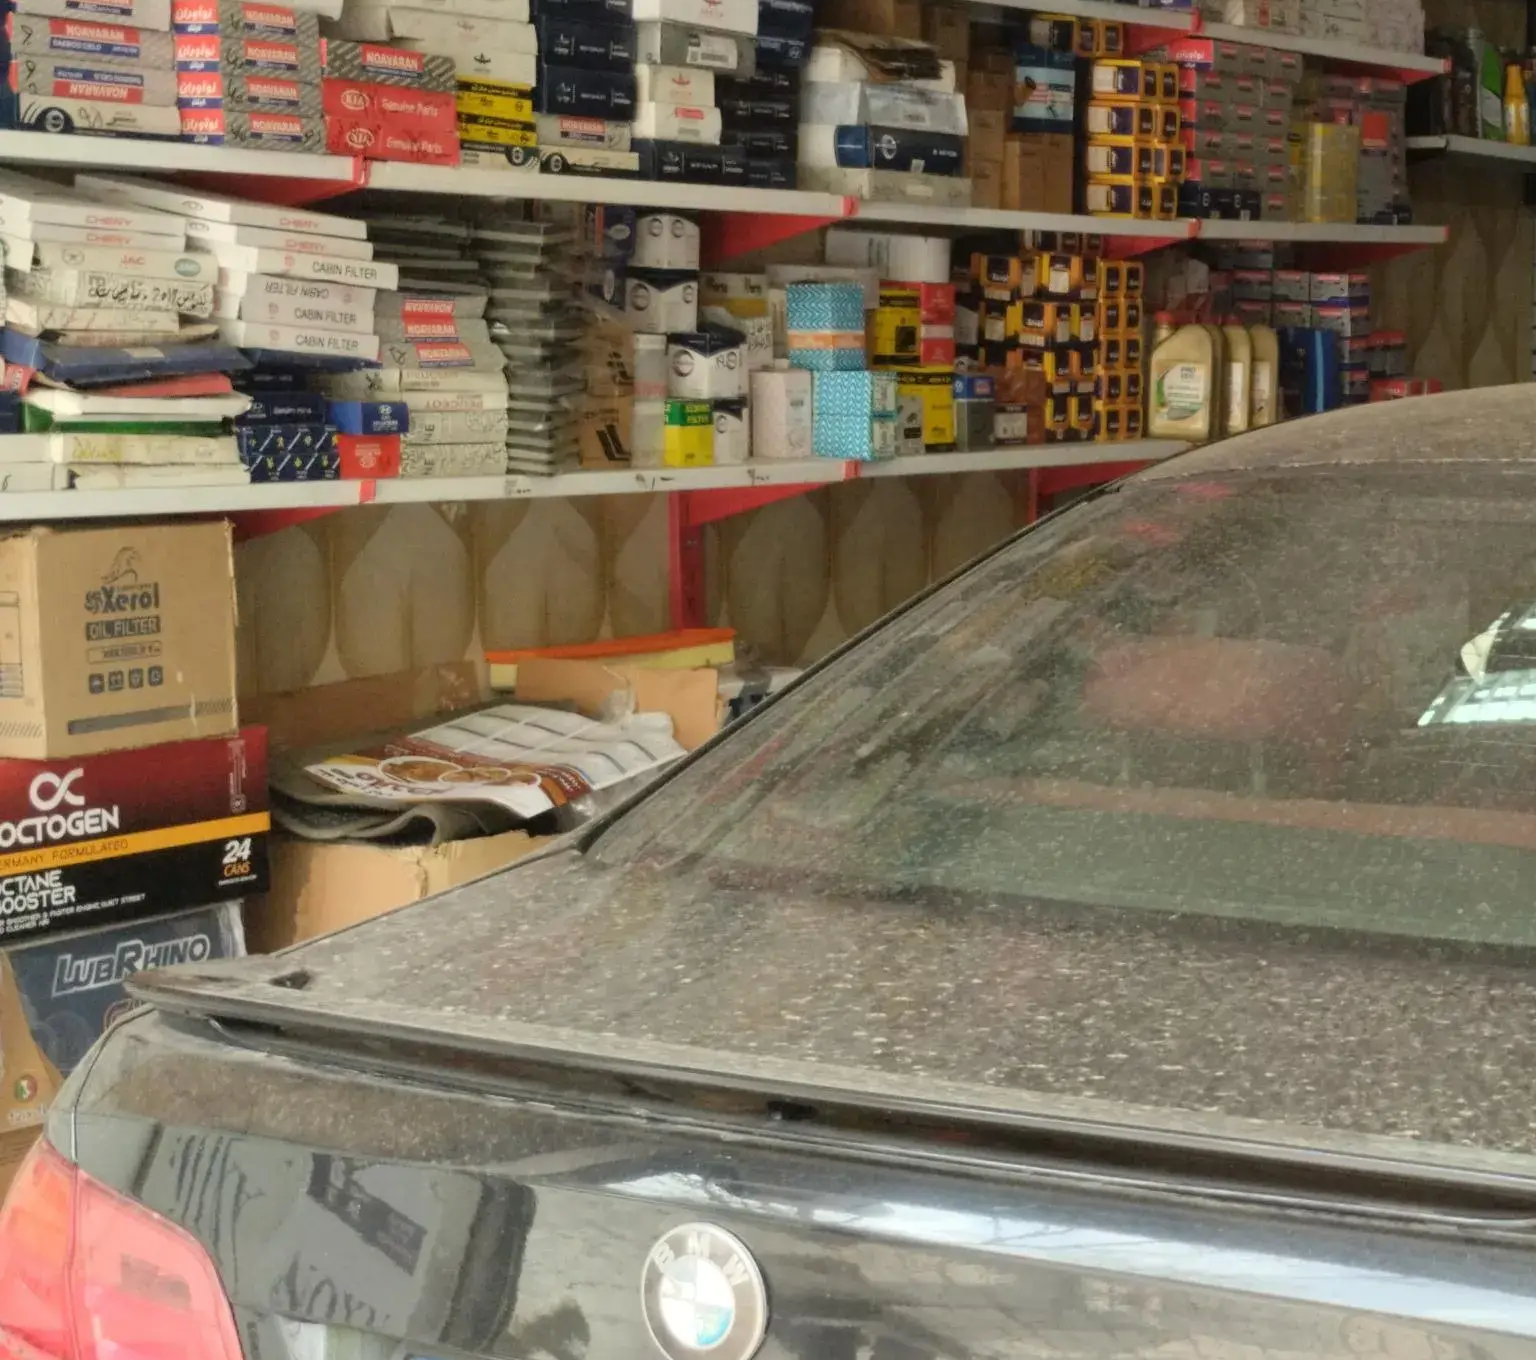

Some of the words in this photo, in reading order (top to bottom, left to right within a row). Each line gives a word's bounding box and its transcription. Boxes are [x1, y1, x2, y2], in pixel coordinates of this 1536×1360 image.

[175, 8, 213, 21] نوآوران
[246, 11, 294, 26] NOAVARAN
[66, 24, 124, 41] NOAVARAN
[178, 44, 215, 59] نوآوران
[247, 47, 296, 62] NOAVARAN
[366, 52, 418, 71] NOAVARAN
[70, 83, 128, 98] NOAVARAN
[180, 81, 216, 95] نوآوران
[346, 93, 364, 106] KIA
[381, 99, 415, 114] Genuine
[417, 101, 438, 117] Parts
[252, 119, 300, 134] NOAVARAN
[421, 141, 442, 155] Parts
[86, 215, 133, 226] CHERY
[279, 218, 319, 229] CHERY
[86, 233, 132, 245] CHERY
[284, 239, 327, 252] CHERY
[121, 255, 144, 265] JAC
[312, 261, 343, 276] CABIN
[345, 265, 377, 280] FILTER
[265, 281, 299, 296] FILTER
[299, 287, 329, 300] CABIN
[294, 308, 323, 321] CABIN
[325, 310, 357, 325] FILTER
[407, 322, 456, 335] NOAVARAN
[295, 334, 324, 349] CABIN
[327, 337, 359, 351] FILTER
[425, 398, 483, 410] PEUGEOT
[101, 582, 160, 614] Xerol
[89, 622, 112, 638] OIL
[113, 618, 158, 636] FILTER
[0, 804, 120, 848] OCTOGEN
[52, 839, 129, 861] FORMULATED
[222, 837, 252, 864] 24
[224, 861, 251, 877] CANS
[0, 869, 62, 897] CTANE
[0, 885, 76, 915] OOSTER
